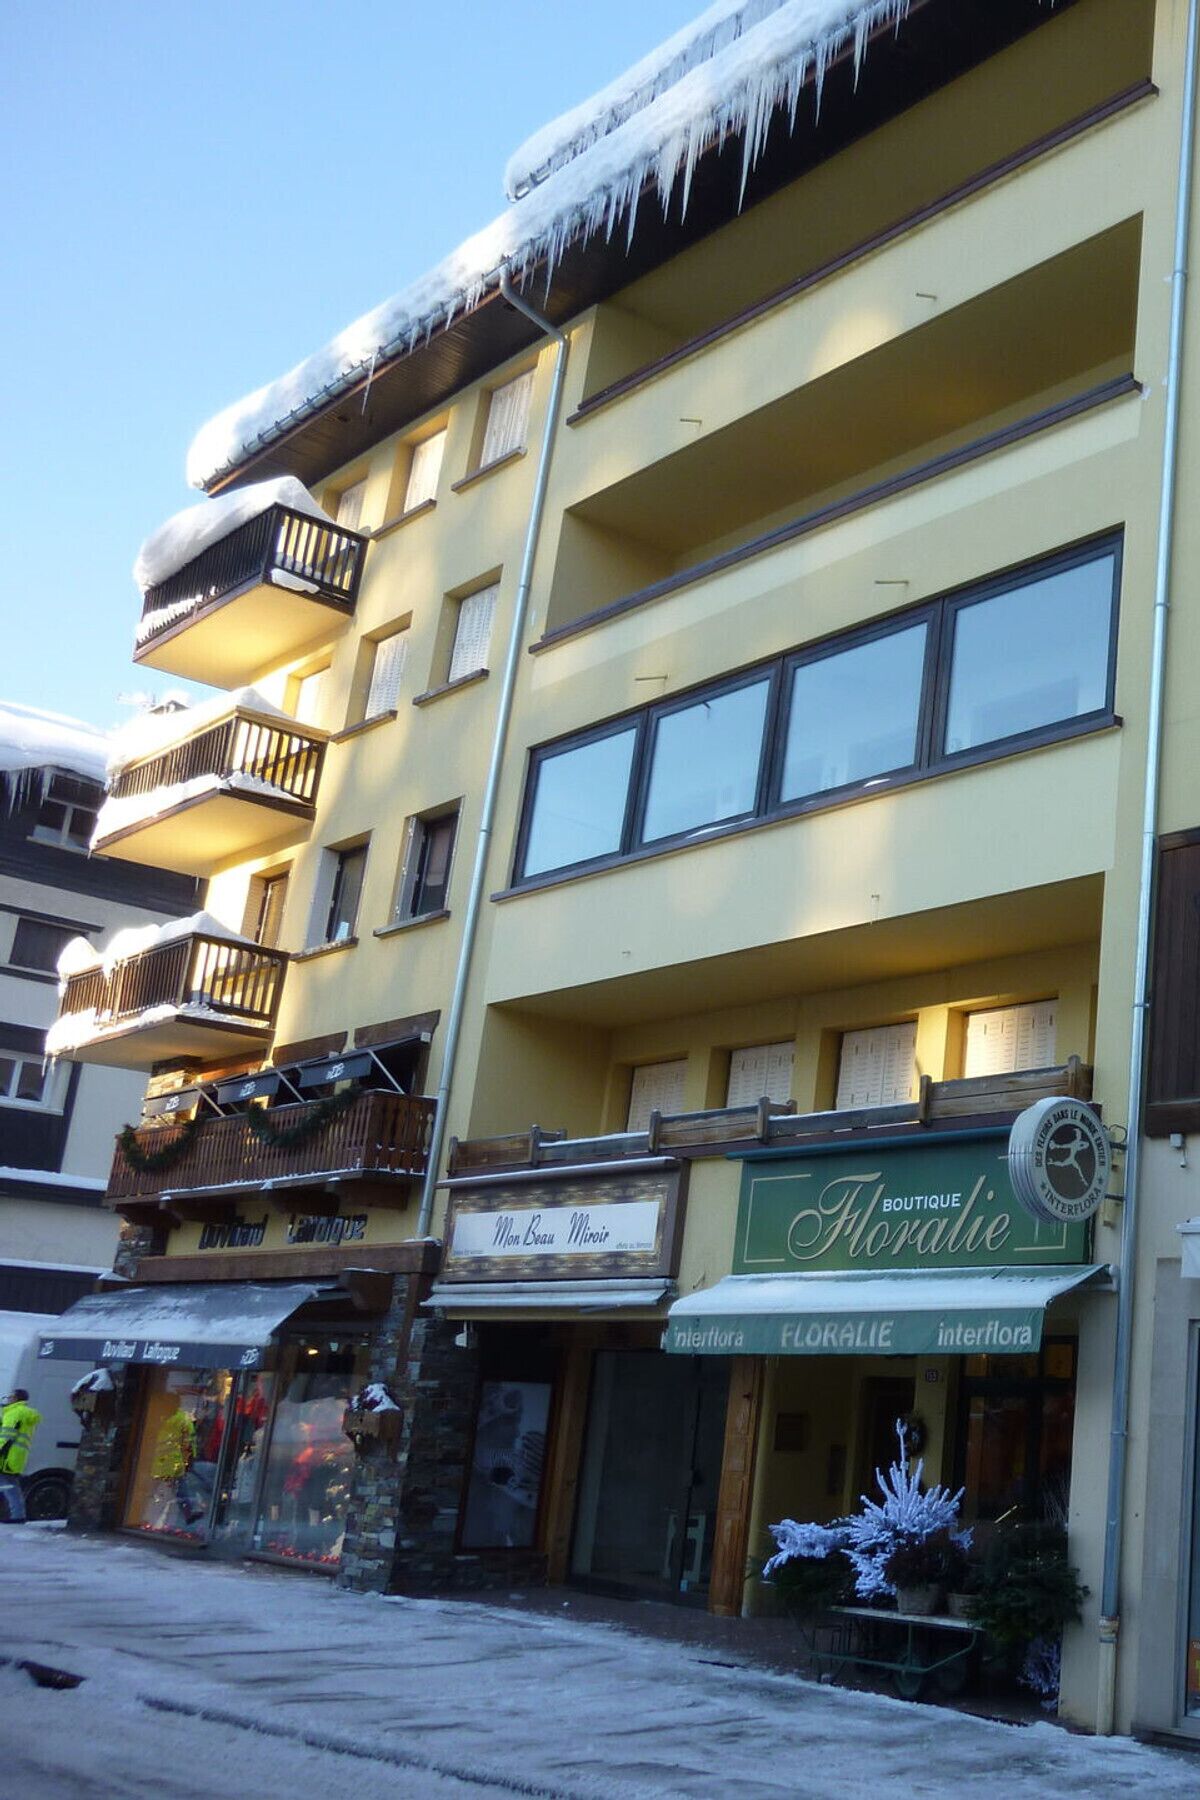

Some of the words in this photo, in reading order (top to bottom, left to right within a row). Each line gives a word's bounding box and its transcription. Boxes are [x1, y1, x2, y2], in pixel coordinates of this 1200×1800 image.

[1052, 1109, 1069, 1123] DANS
[1069, 1109, 1078, 1120] LE
[788, 1171, 1011, 1260] Floralie
[882, 1193, 962, 1212] BOUTIQUE
[1045, 1187, 1101, 1216] INTERFLORA
[493, 1214, 520, 1248] Mon
[523, 1213, 554, 1246] Beau
[567, 1211, 610, 1247] Miroir
[781, 1320, 895, 1348] FLORALIE
[937, 1320, 1032, 1346] interflora
